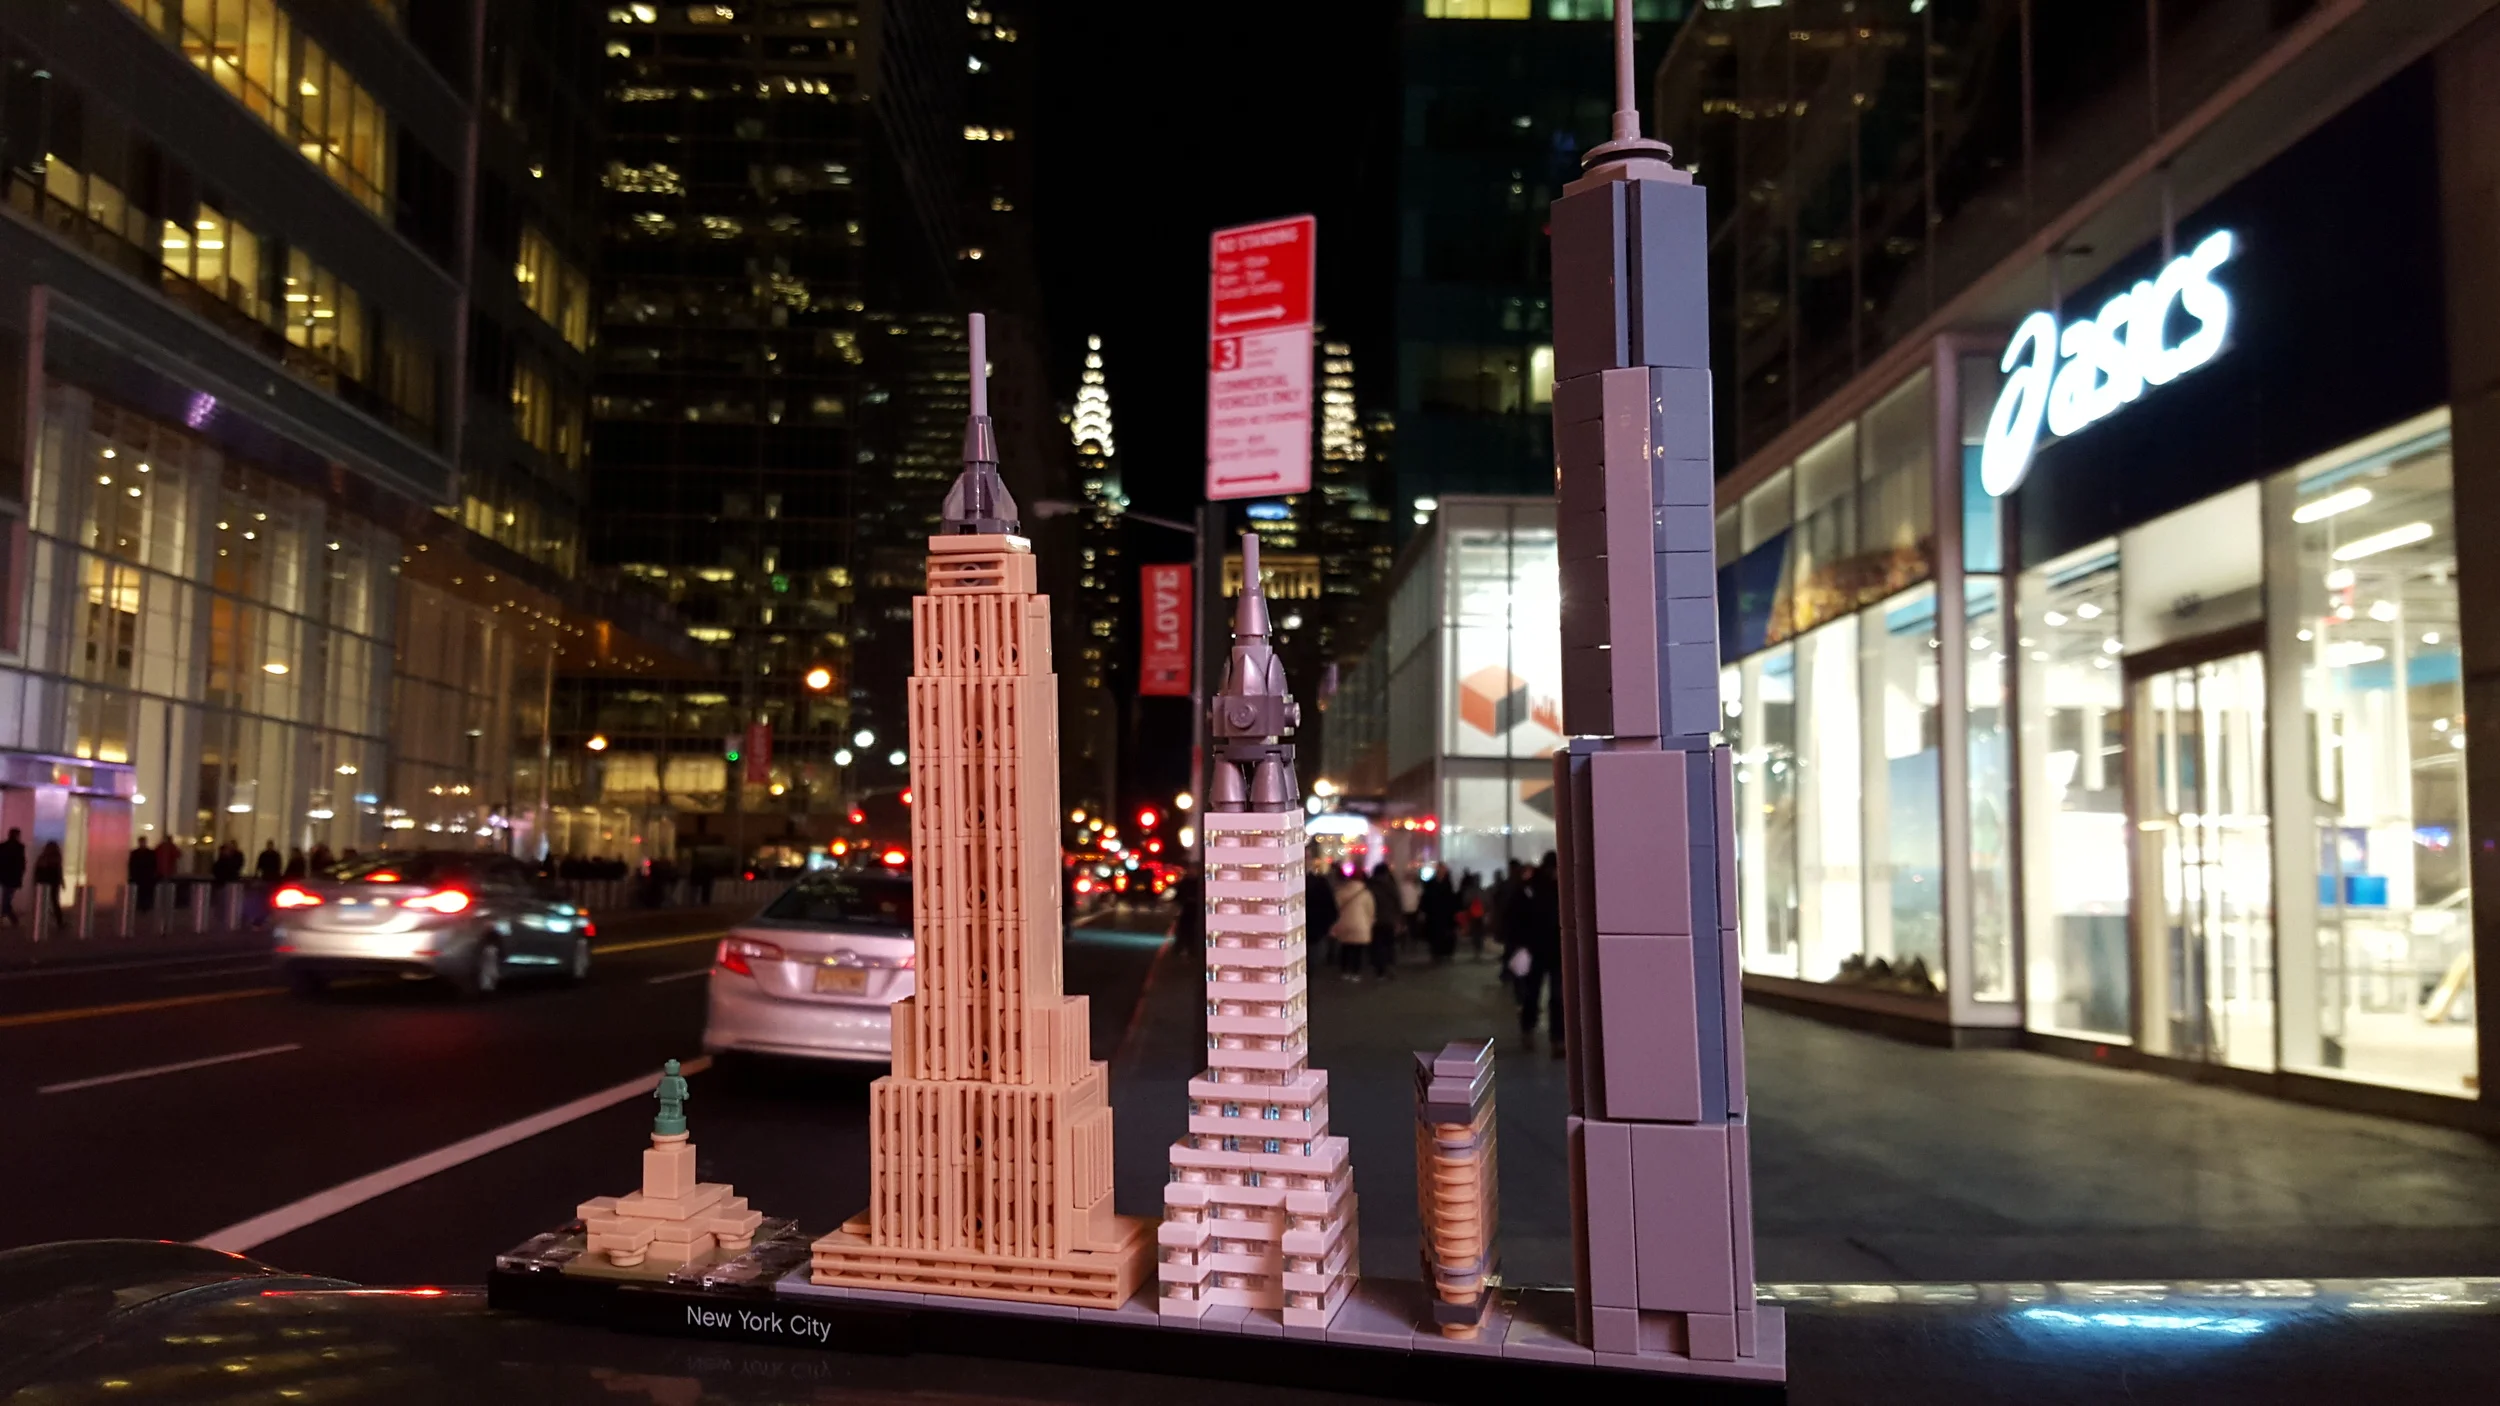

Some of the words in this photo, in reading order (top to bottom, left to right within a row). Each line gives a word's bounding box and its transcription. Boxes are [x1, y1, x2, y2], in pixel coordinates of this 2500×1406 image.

[1220, 340, 1236, 369] 3
[1154, 570, 1179, 651] LOVE
[686, 1305, 732, 1329] New
[738, 1309, 784, 1334] York
[790, 1314, 832, 1343] City
